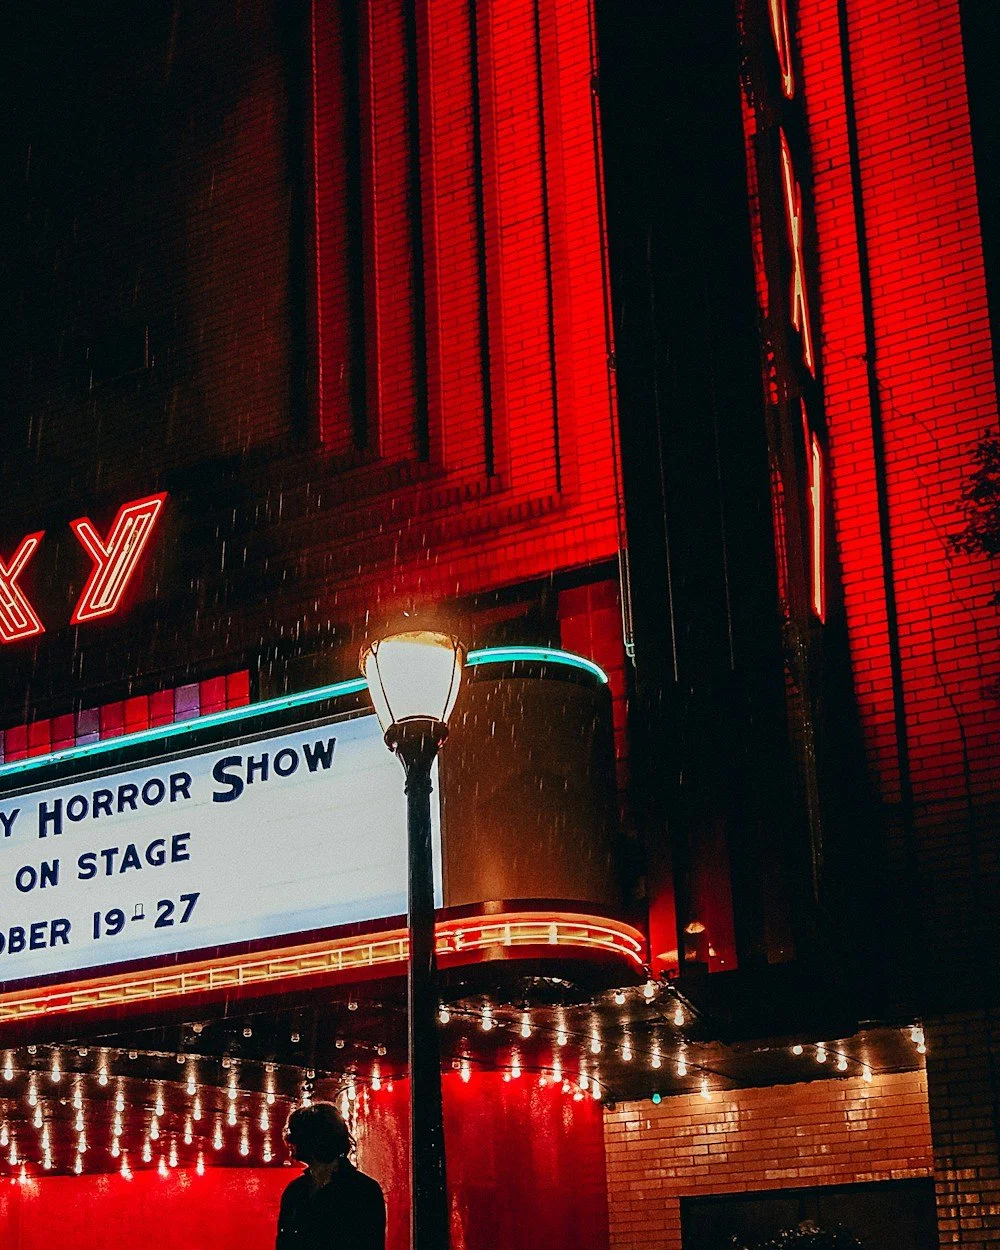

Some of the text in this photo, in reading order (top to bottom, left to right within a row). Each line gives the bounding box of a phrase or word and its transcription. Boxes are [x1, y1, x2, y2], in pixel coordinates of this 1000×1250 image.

[39, 771, 192, 838] HORROR
[212, 737, 336, 803] SHOW
[15, 859, 60, 892] ON
[77, 832, 191, 880] STAGE
